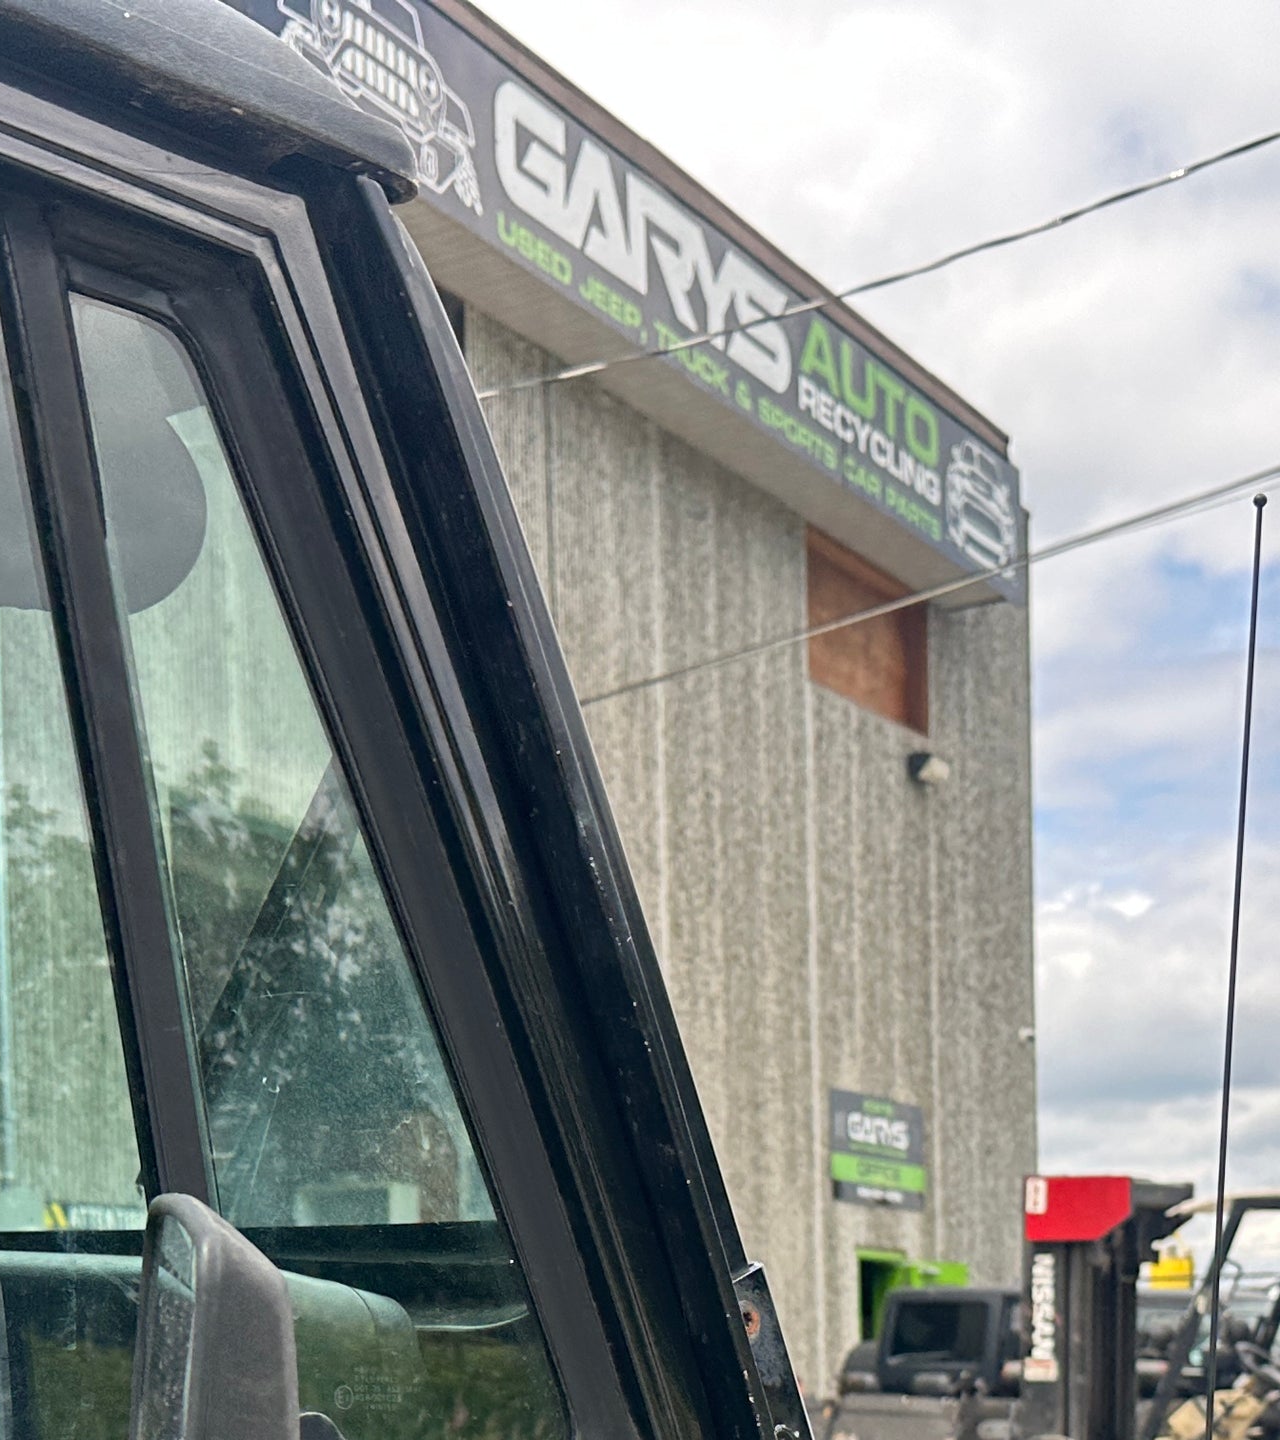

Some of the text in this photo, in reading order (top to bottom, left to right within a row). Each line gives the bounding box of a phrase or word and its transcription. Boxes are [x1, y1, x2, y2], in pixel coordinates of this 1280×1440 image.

[494, 80, 792, 394] GARYS
[496, 210, 572, 286] USED
[652, 317, 730, 397] TRUCK
[734, 378, 753, 412] &
[757, 396, 839, 471] SPORTS
[842, 455, 883, 501] CAR
[885, 486, 942, 543] PARTS
[797, 373, 942, 507] RECYCLING
[800, 317, 939, 469] AUTO
